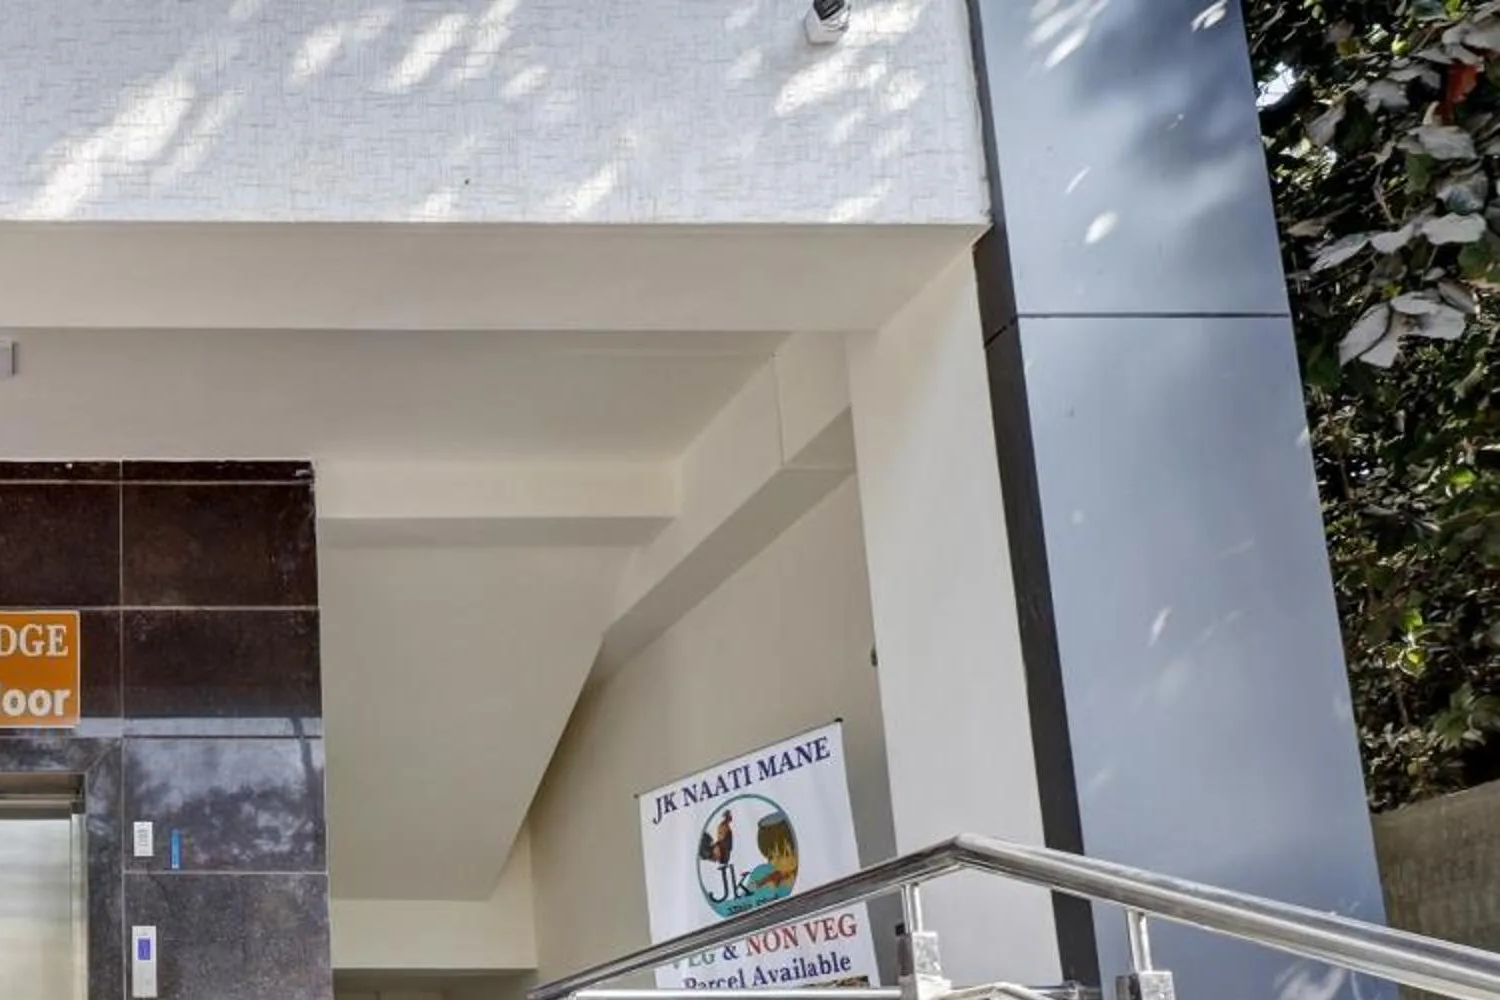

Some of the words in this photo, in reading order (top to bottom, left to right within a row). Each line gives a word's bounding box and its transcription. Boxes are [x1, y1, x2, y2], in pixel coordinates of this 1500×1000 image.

[653, 791, 678, 825] JK
[682, 763, 753, 807] NAATI
[757, 736, 831, 781] MANE
[723, 943, 740, 961] &
[746, 924, 798, 957] NON
[803, 913, 858, 944] VEG
[752, 951, 852, 987] Available
